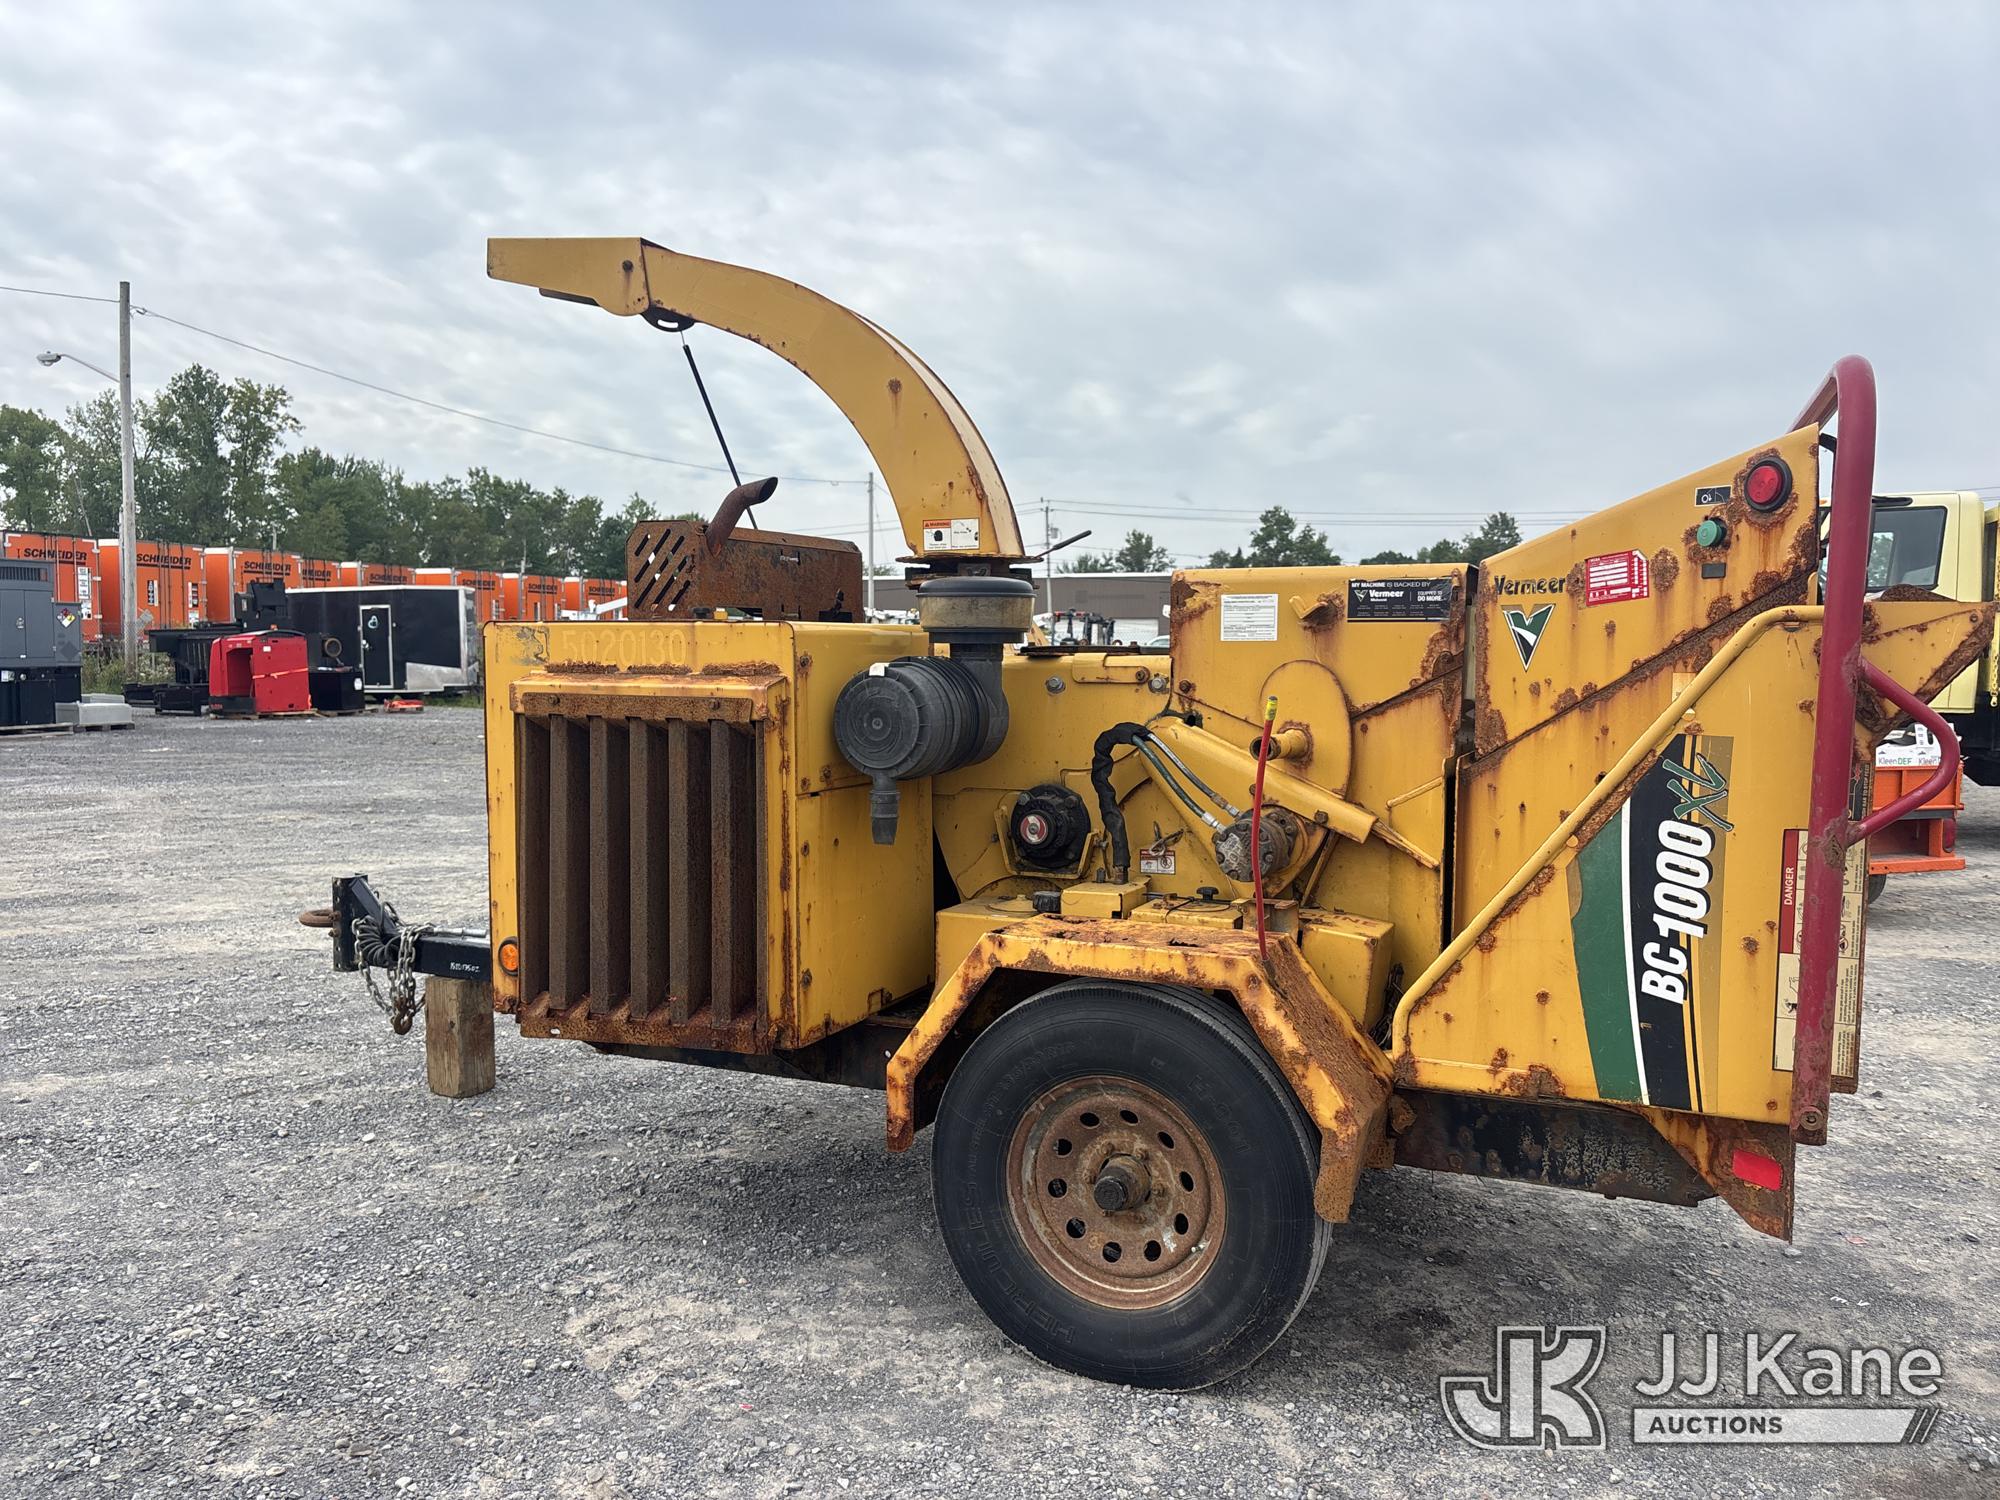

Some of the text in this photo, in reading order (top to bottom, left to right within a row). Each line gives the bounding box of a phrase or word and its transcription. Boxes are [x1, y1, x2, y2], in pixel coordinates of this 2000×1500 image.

[24, 548, 87, 560] SCHNEIDER
[136, 553, 192, 566] SCHNEIDER
[244, 560, 291, 572] SCHNEIDER
[1369, 589, 1404, 598] Vermeer
[1494, 575, 1566, 595] Vermeer
[562, 628, 687, 665] 5020130
[1662, 753, 1734, 833] XL
[1783, 867, 1794, 906] DANGER
[1640, 819, 1716, 1006] BC 1000
